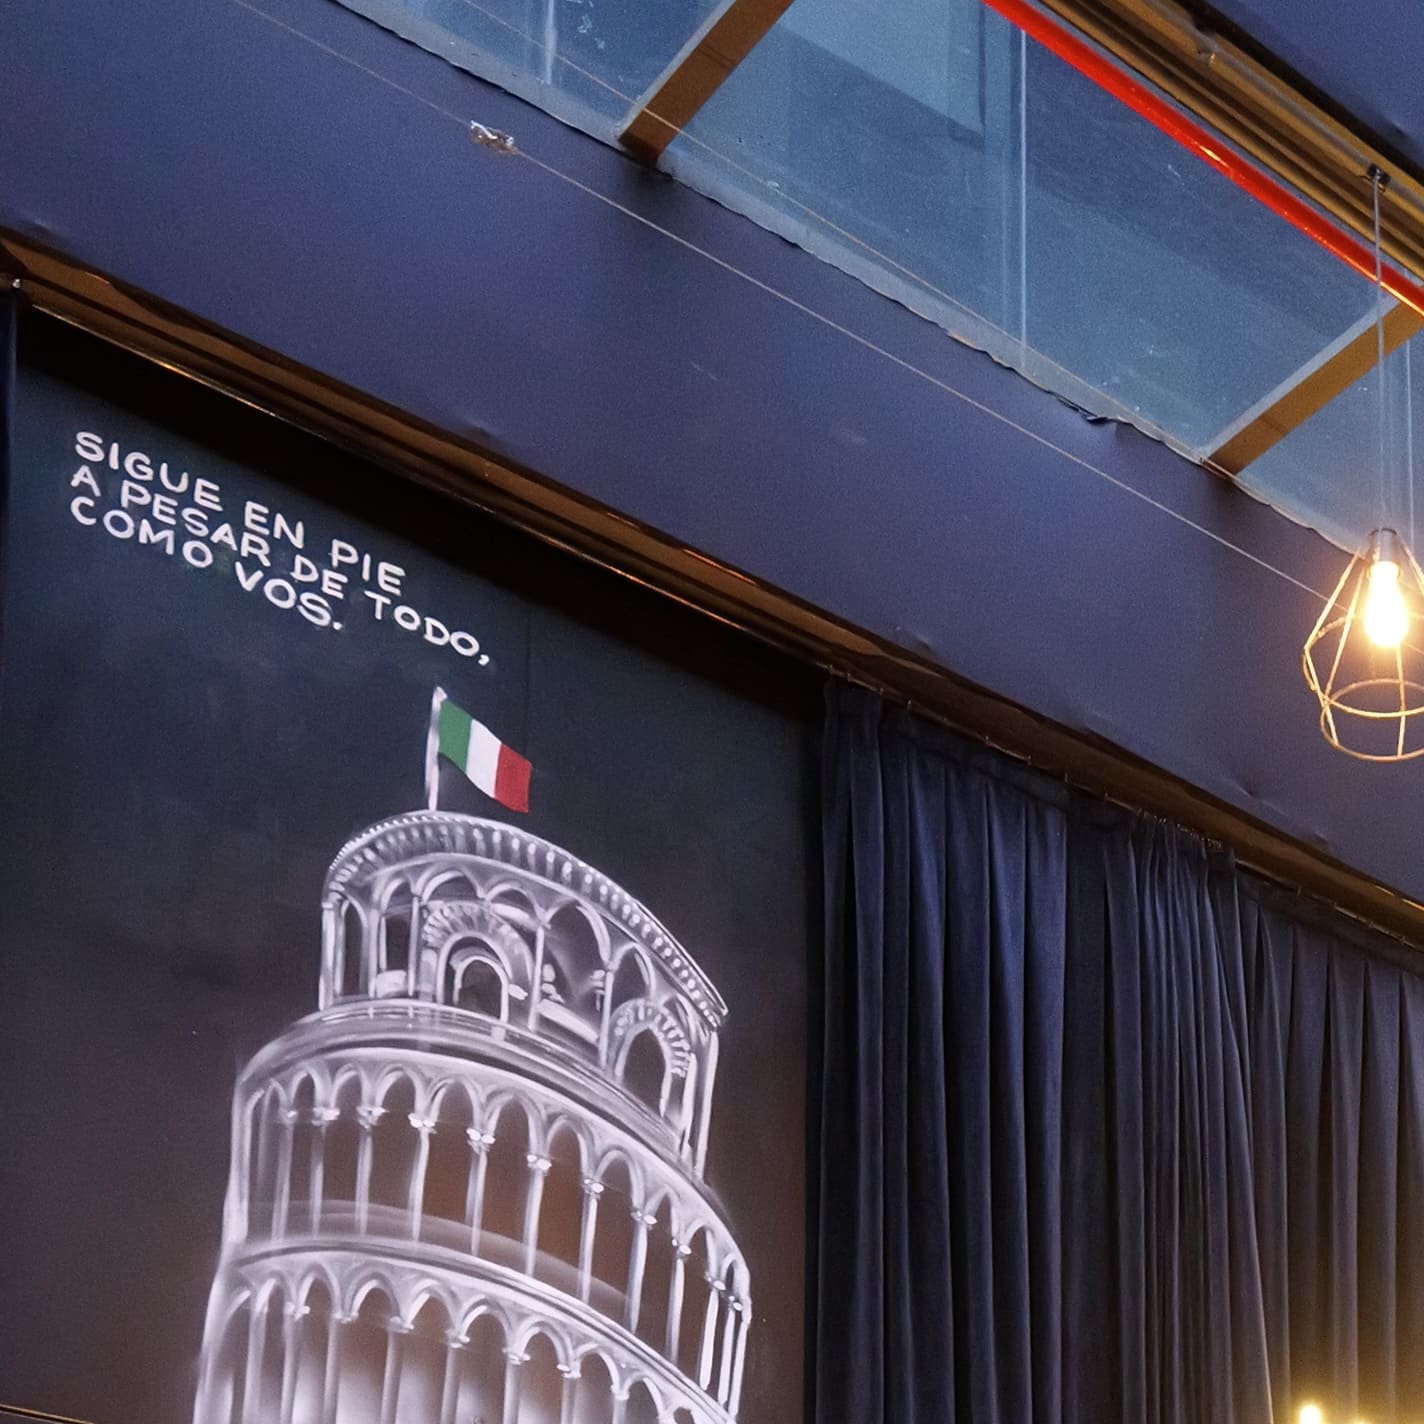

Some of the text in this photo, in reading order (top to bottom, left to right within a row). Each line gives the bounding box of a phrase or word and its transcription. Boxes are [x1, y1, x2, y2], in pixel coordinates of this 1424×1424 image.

[70, 495, 343, 631] COMO VOS.
[70, 464, 490, 666] A PESAR DE TODO,
[75, 431, 406, 596] SIGUE EN PIE
